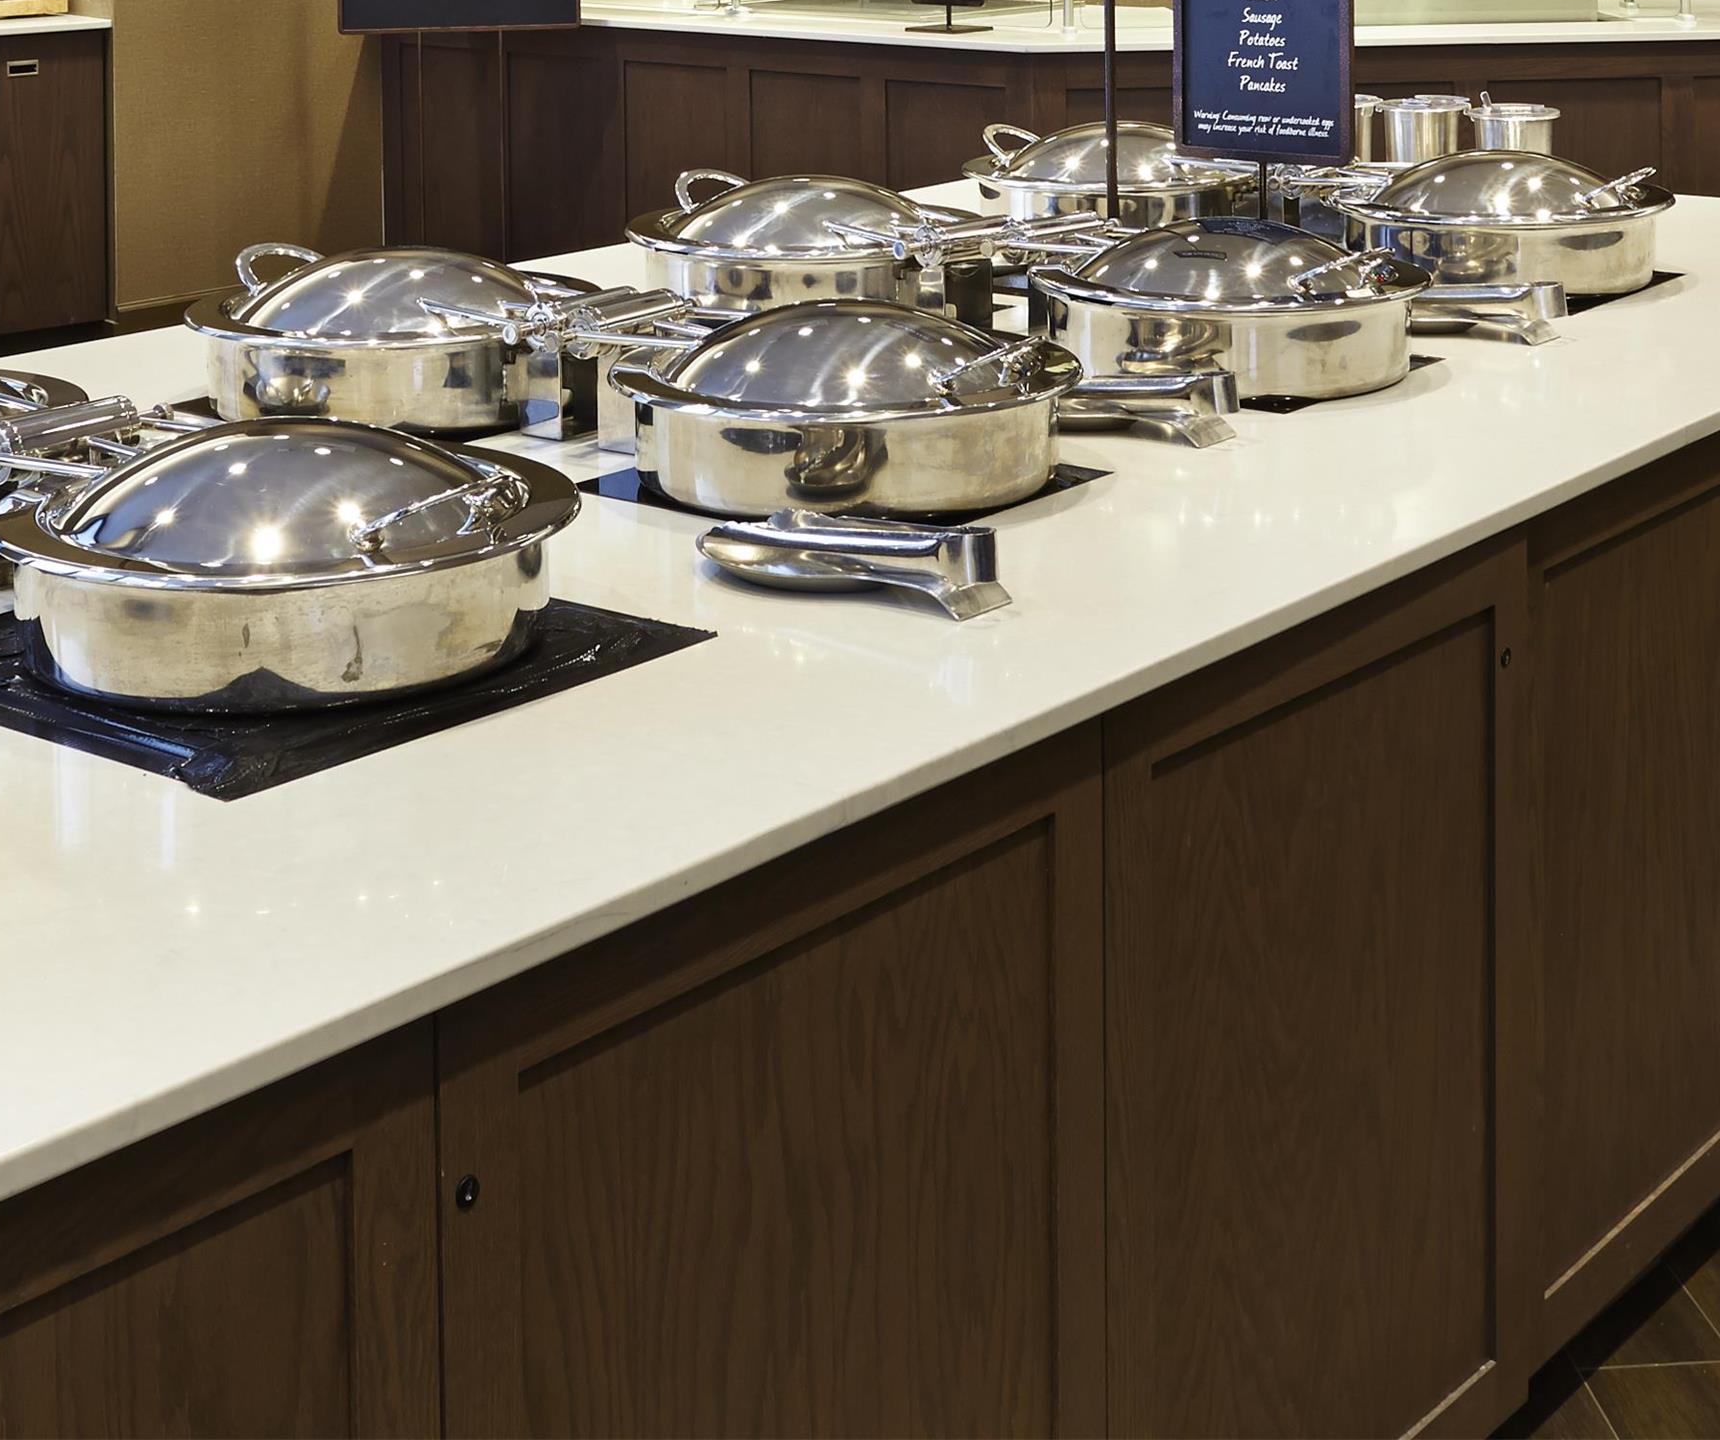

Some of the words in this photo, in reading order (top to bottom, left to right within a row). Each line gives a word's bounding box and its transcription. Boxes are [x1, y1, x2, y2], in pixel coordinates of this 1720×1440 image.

[1242, 7, 1282, 30] Sausage
[1240, 30, 1285, 46] Potatoes
[1228, 52, 1264, 68] French
[1268, 53, 1298, 70] Toast
[1240, 75, 1286, 92] Pancakes
[1222, 110, 1256, 126] Consuming
[1258, 115, 1272, 123] raw
[1281, 116, 1320, 126] undercooked
[1321, 119, 1335, 131] eggs
[1198, 123, 1211, 134] may
[1238, 126, 1253, 136] your
[1254, 124, 1267, 134] risk
